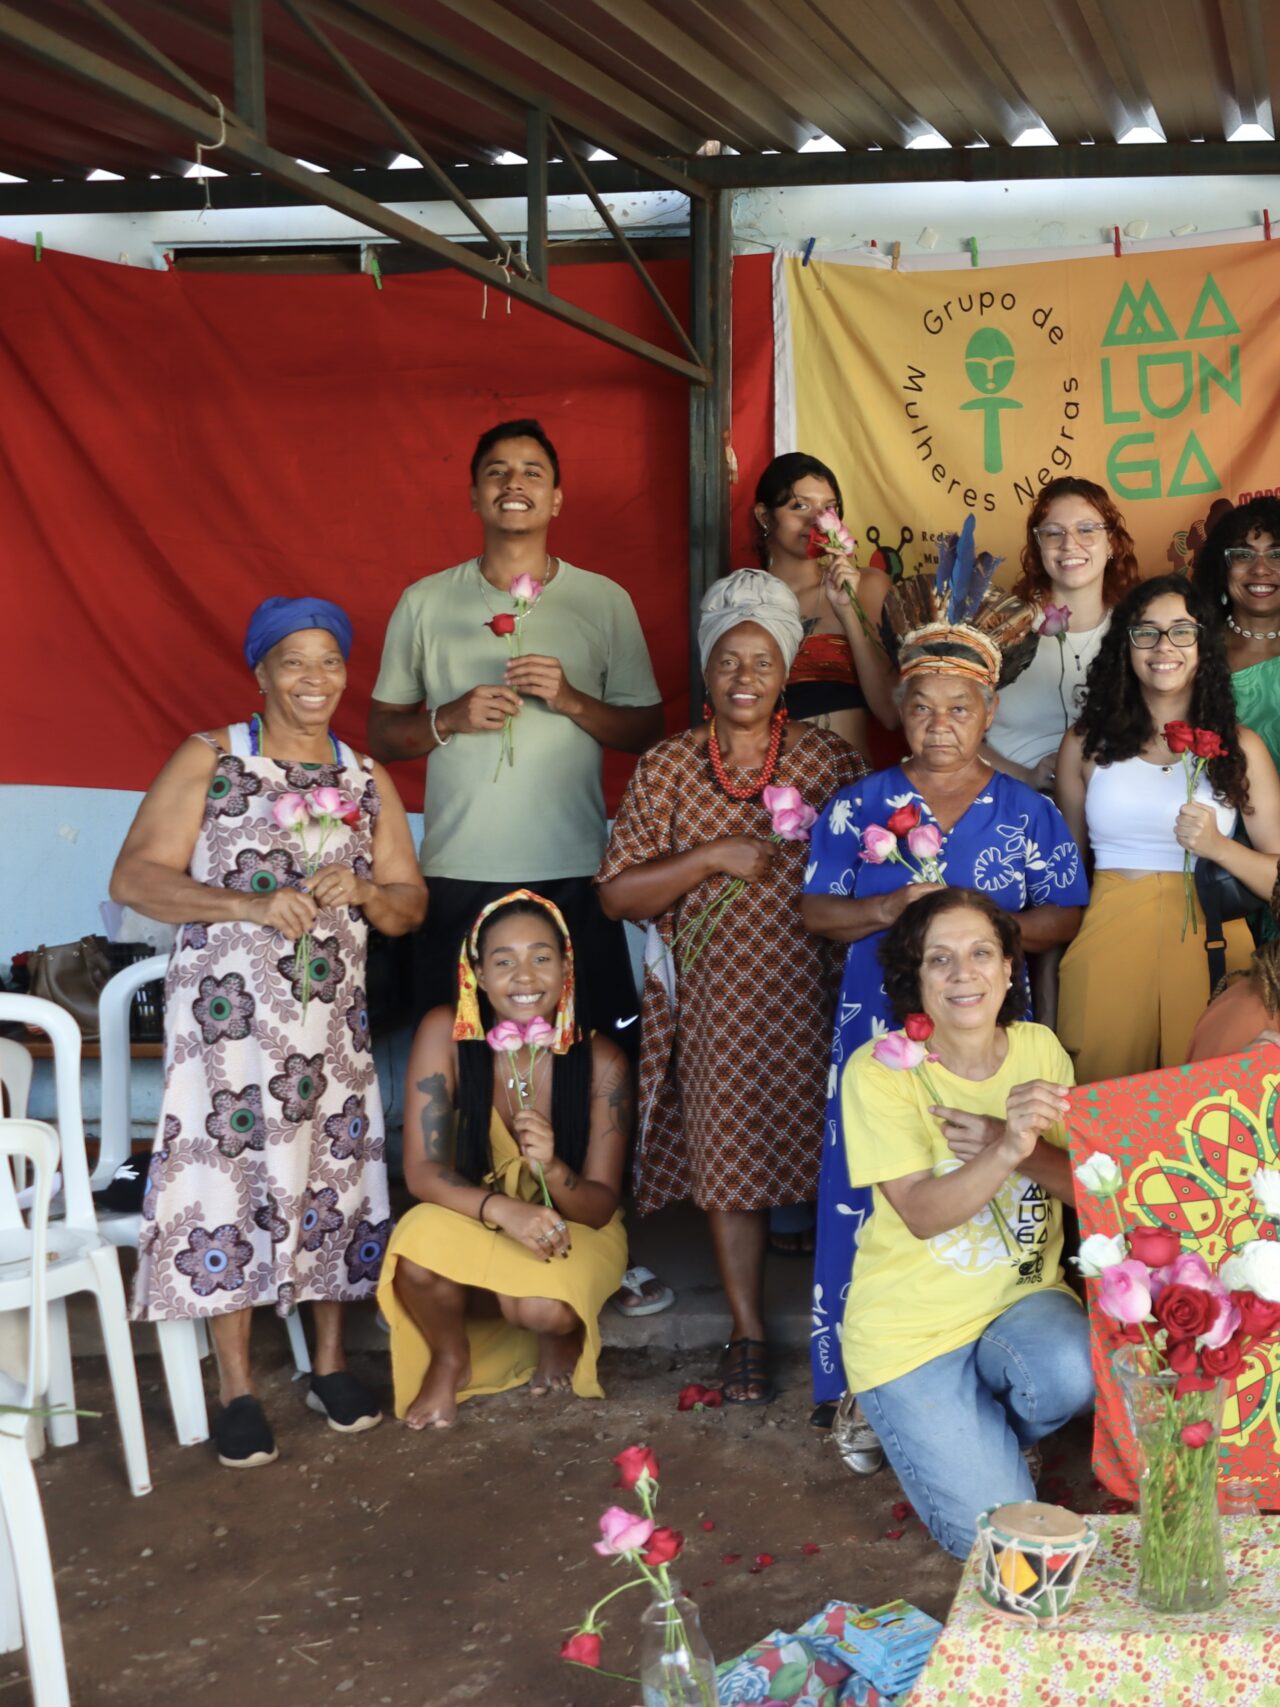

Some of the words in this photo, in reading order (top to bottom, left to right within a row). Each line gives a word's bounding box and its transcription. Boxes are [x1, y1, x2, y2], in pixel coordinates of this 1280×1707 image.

[923, 291, 1016, 335] Grupo
[1032, 307, 1064, 345] de
[903, 365, 996, 511] Mulheres
[1013, 377, 1080, 505] Negras
